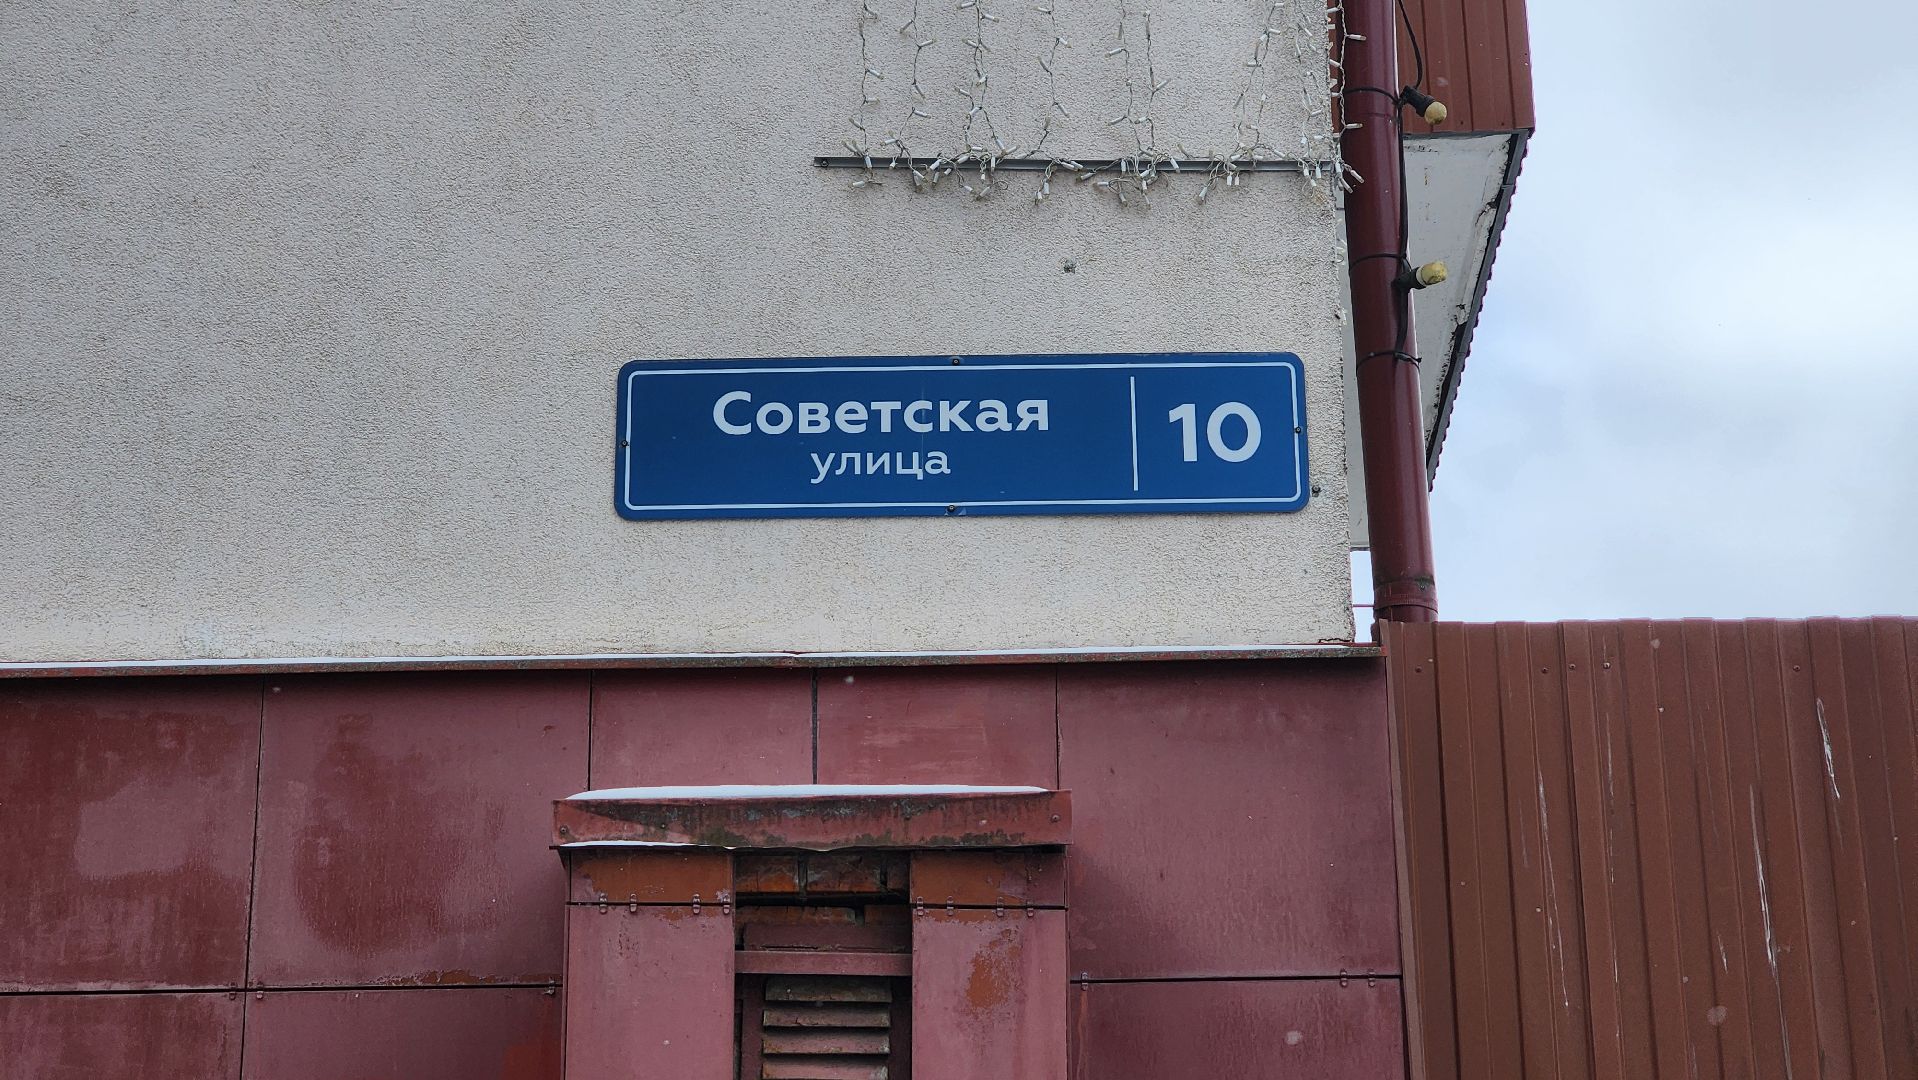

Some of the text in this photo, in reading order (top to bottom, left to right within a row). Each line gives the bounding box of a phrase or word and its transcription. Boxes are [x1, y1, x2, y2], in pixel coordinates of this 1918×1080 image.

[712, 390, 1050, 435] Советская
[1168, 401, 1262, 463] 10
[810, 450, 951, 485] улица
